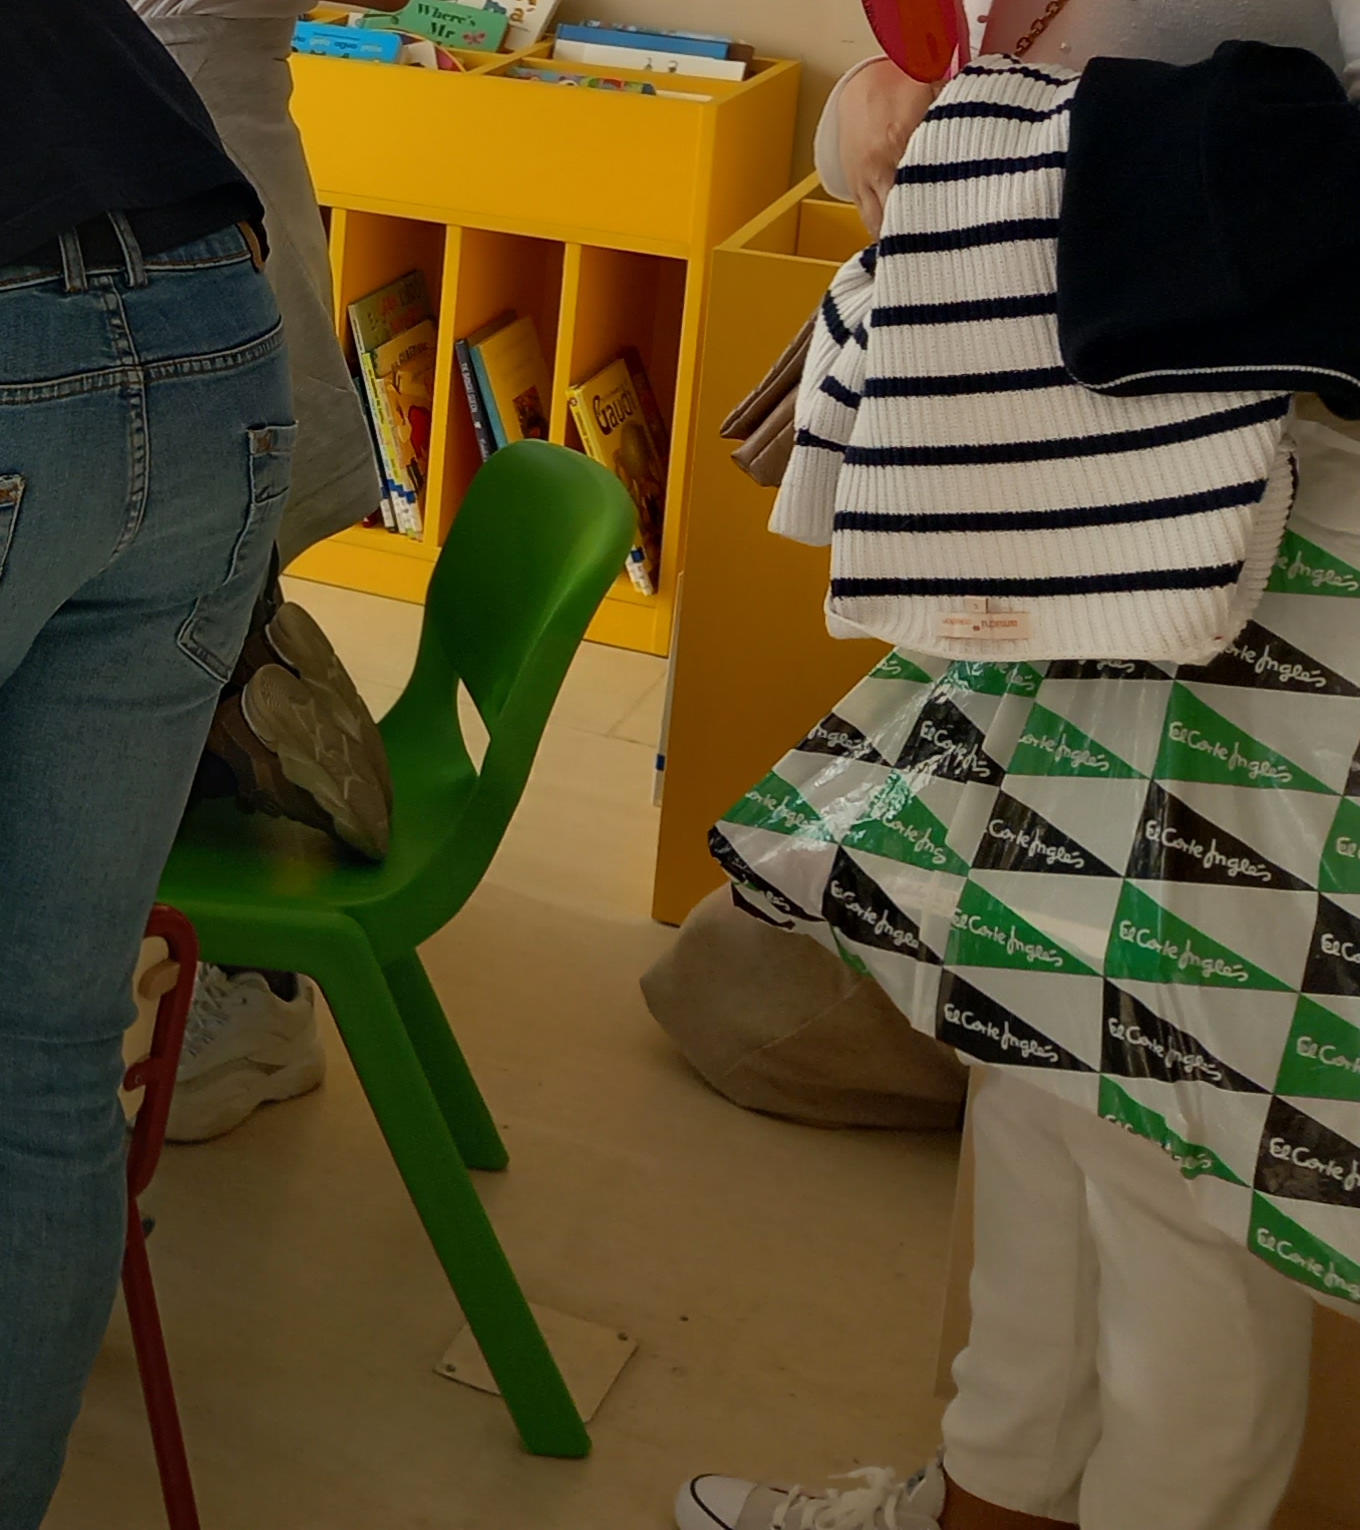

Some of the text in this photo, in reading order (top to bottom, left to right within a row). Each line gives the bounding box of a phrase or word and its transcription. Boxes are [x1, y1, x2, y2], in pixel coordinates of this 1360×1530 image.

[417, 3, 476, 28] Where's
[430, 22, 456, 39] Mr
[1255, 644, 1326, 688] Inglés
[1054, 733, 1109, 771] Inglés
[1169, 721, 1292, 782] El Corte Inglés
[989, 818, 1084, 868] Corte Inglés
[1145, 819, 1272, 882] El Corte Inglés
[1336, 836, 1356, 858] El
[967, 915, 1007, 946] Corte
[1006, 924, 1063, 967] Inglés
[1119, 919, 1249, 983] El Corte Inglés
[1321, 933, 1341, 955] El
[943, 1002, 1059, 1062] El Corte Inglés
[1108, 1017, 1126, 1040] El
[1125, 1026, 1166, 1059] Corte
[1296, 1035, 1318, 1057] El
[1269, 1137, 1290, 1161] El
[1291, 1146, 1344, 1180] Corte
[1256, 1228, 1276, 1253] El
[1275, 1241, 1324, 1276] Corte
